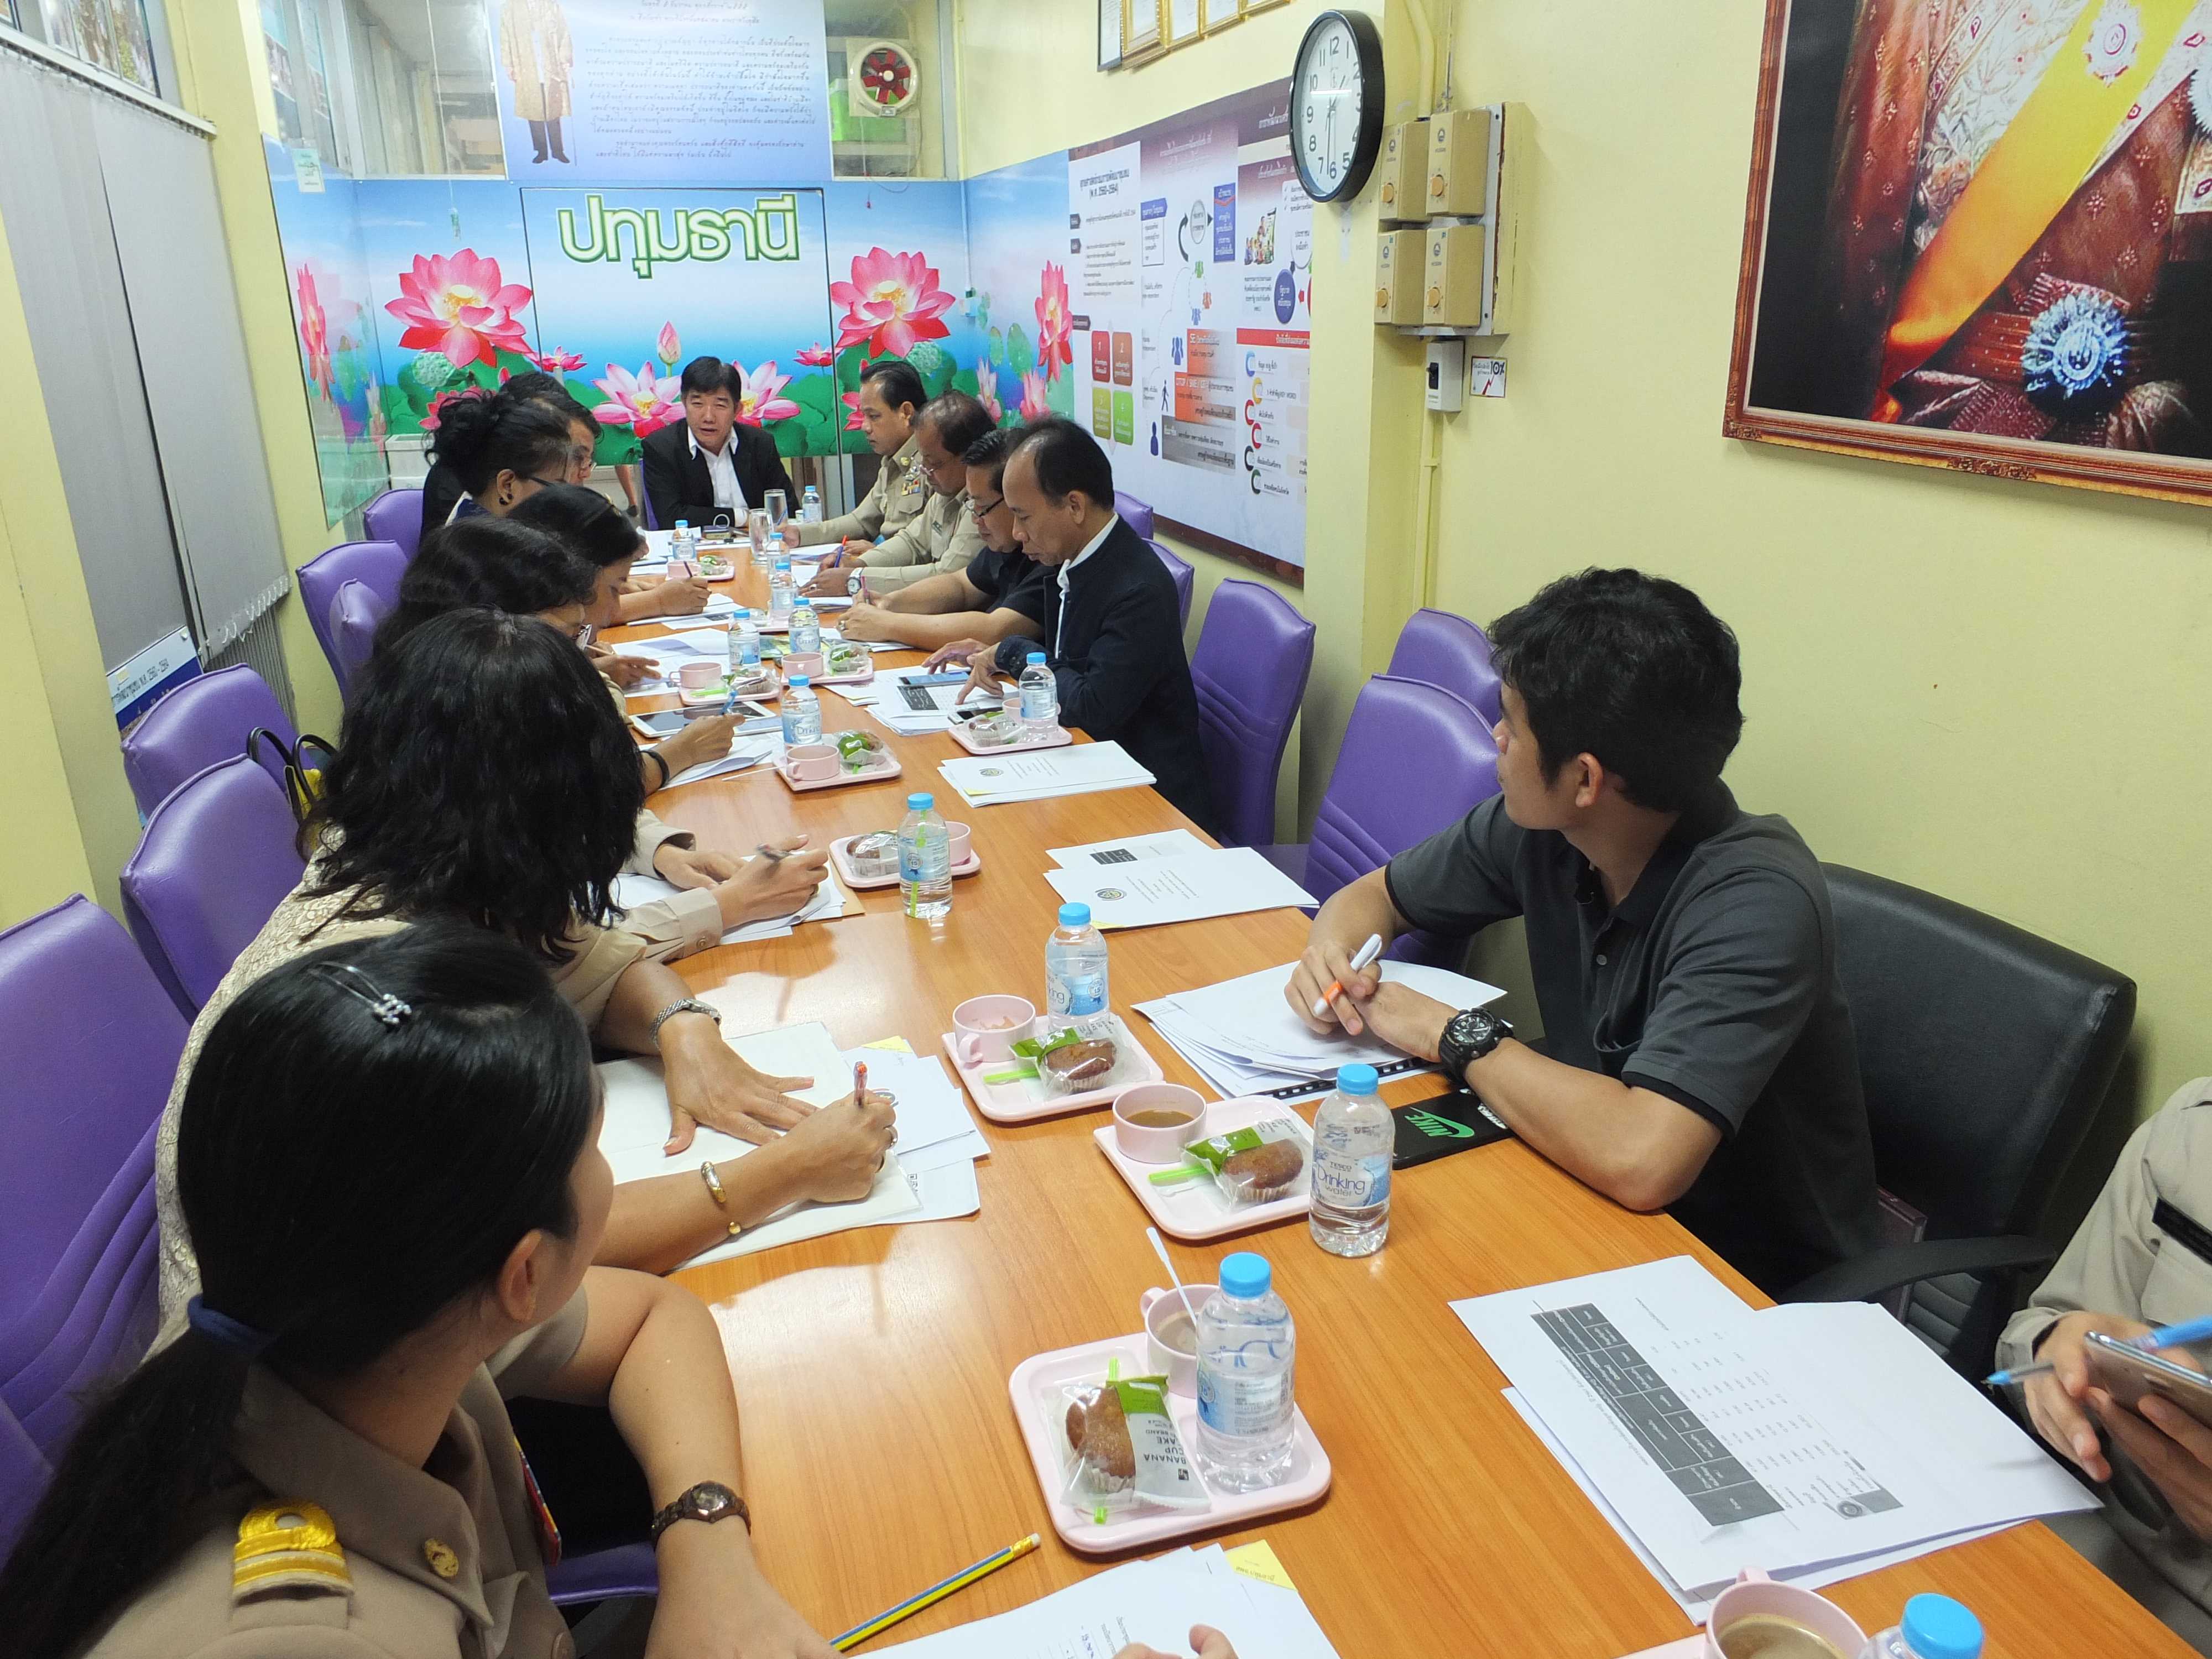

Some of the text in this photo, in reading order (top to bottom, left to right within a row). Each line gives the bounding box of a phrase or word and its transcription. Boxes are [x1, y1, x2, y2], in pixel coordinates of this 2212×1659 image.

[1329, 36, 1339, 55] 12
[1319, 49, 1326, 67] 11
[1353, 62, 1360, 80] 2
[1310, 74, 1318, 92] 10
[1306, 106, 1313, 123] 9
[1309, 135, 1317, 152] 8
[1318, 157, 1324, 174] 7
[1342, 152, 1350, 170] 5
[1329, 162, 1337, 179] 6
[556, 192, 800, 279] ปทุมธานี
[1490, 361, 1505, 375] 10%
[1405, 1114, 1453, 1137] NIKE
[1329, 1161, 1352, 1170] TESCO
[1317, 1164, 1365, 1195] Drinking
[1325, 1185, 1352, 1197] water
[1143, 1453, 1186, 1464] BANANA
[1165, 1447, 1183, 1455] CUP
